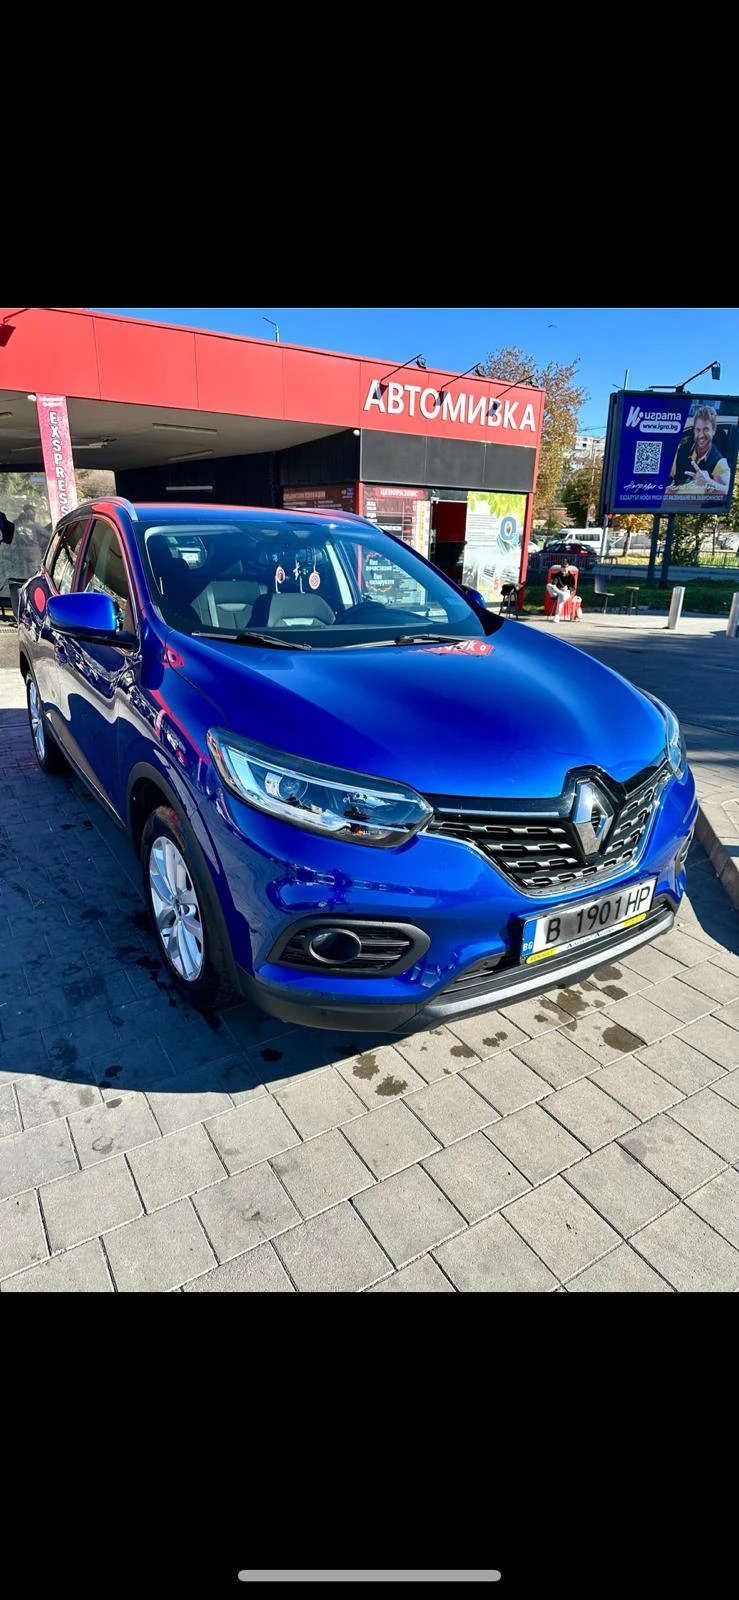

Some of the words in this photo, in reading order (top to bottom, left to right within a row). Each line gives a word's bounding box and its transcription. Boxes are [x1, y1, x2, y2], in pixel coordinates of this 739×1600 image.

[363, 379, 537, 432] АВТОМИВКА
[545, 917, 561, 944] B
[576, 897, 622, 934] 1901
[625, 886, 651, 916] HP
[523, 941, 534, 951] BG
